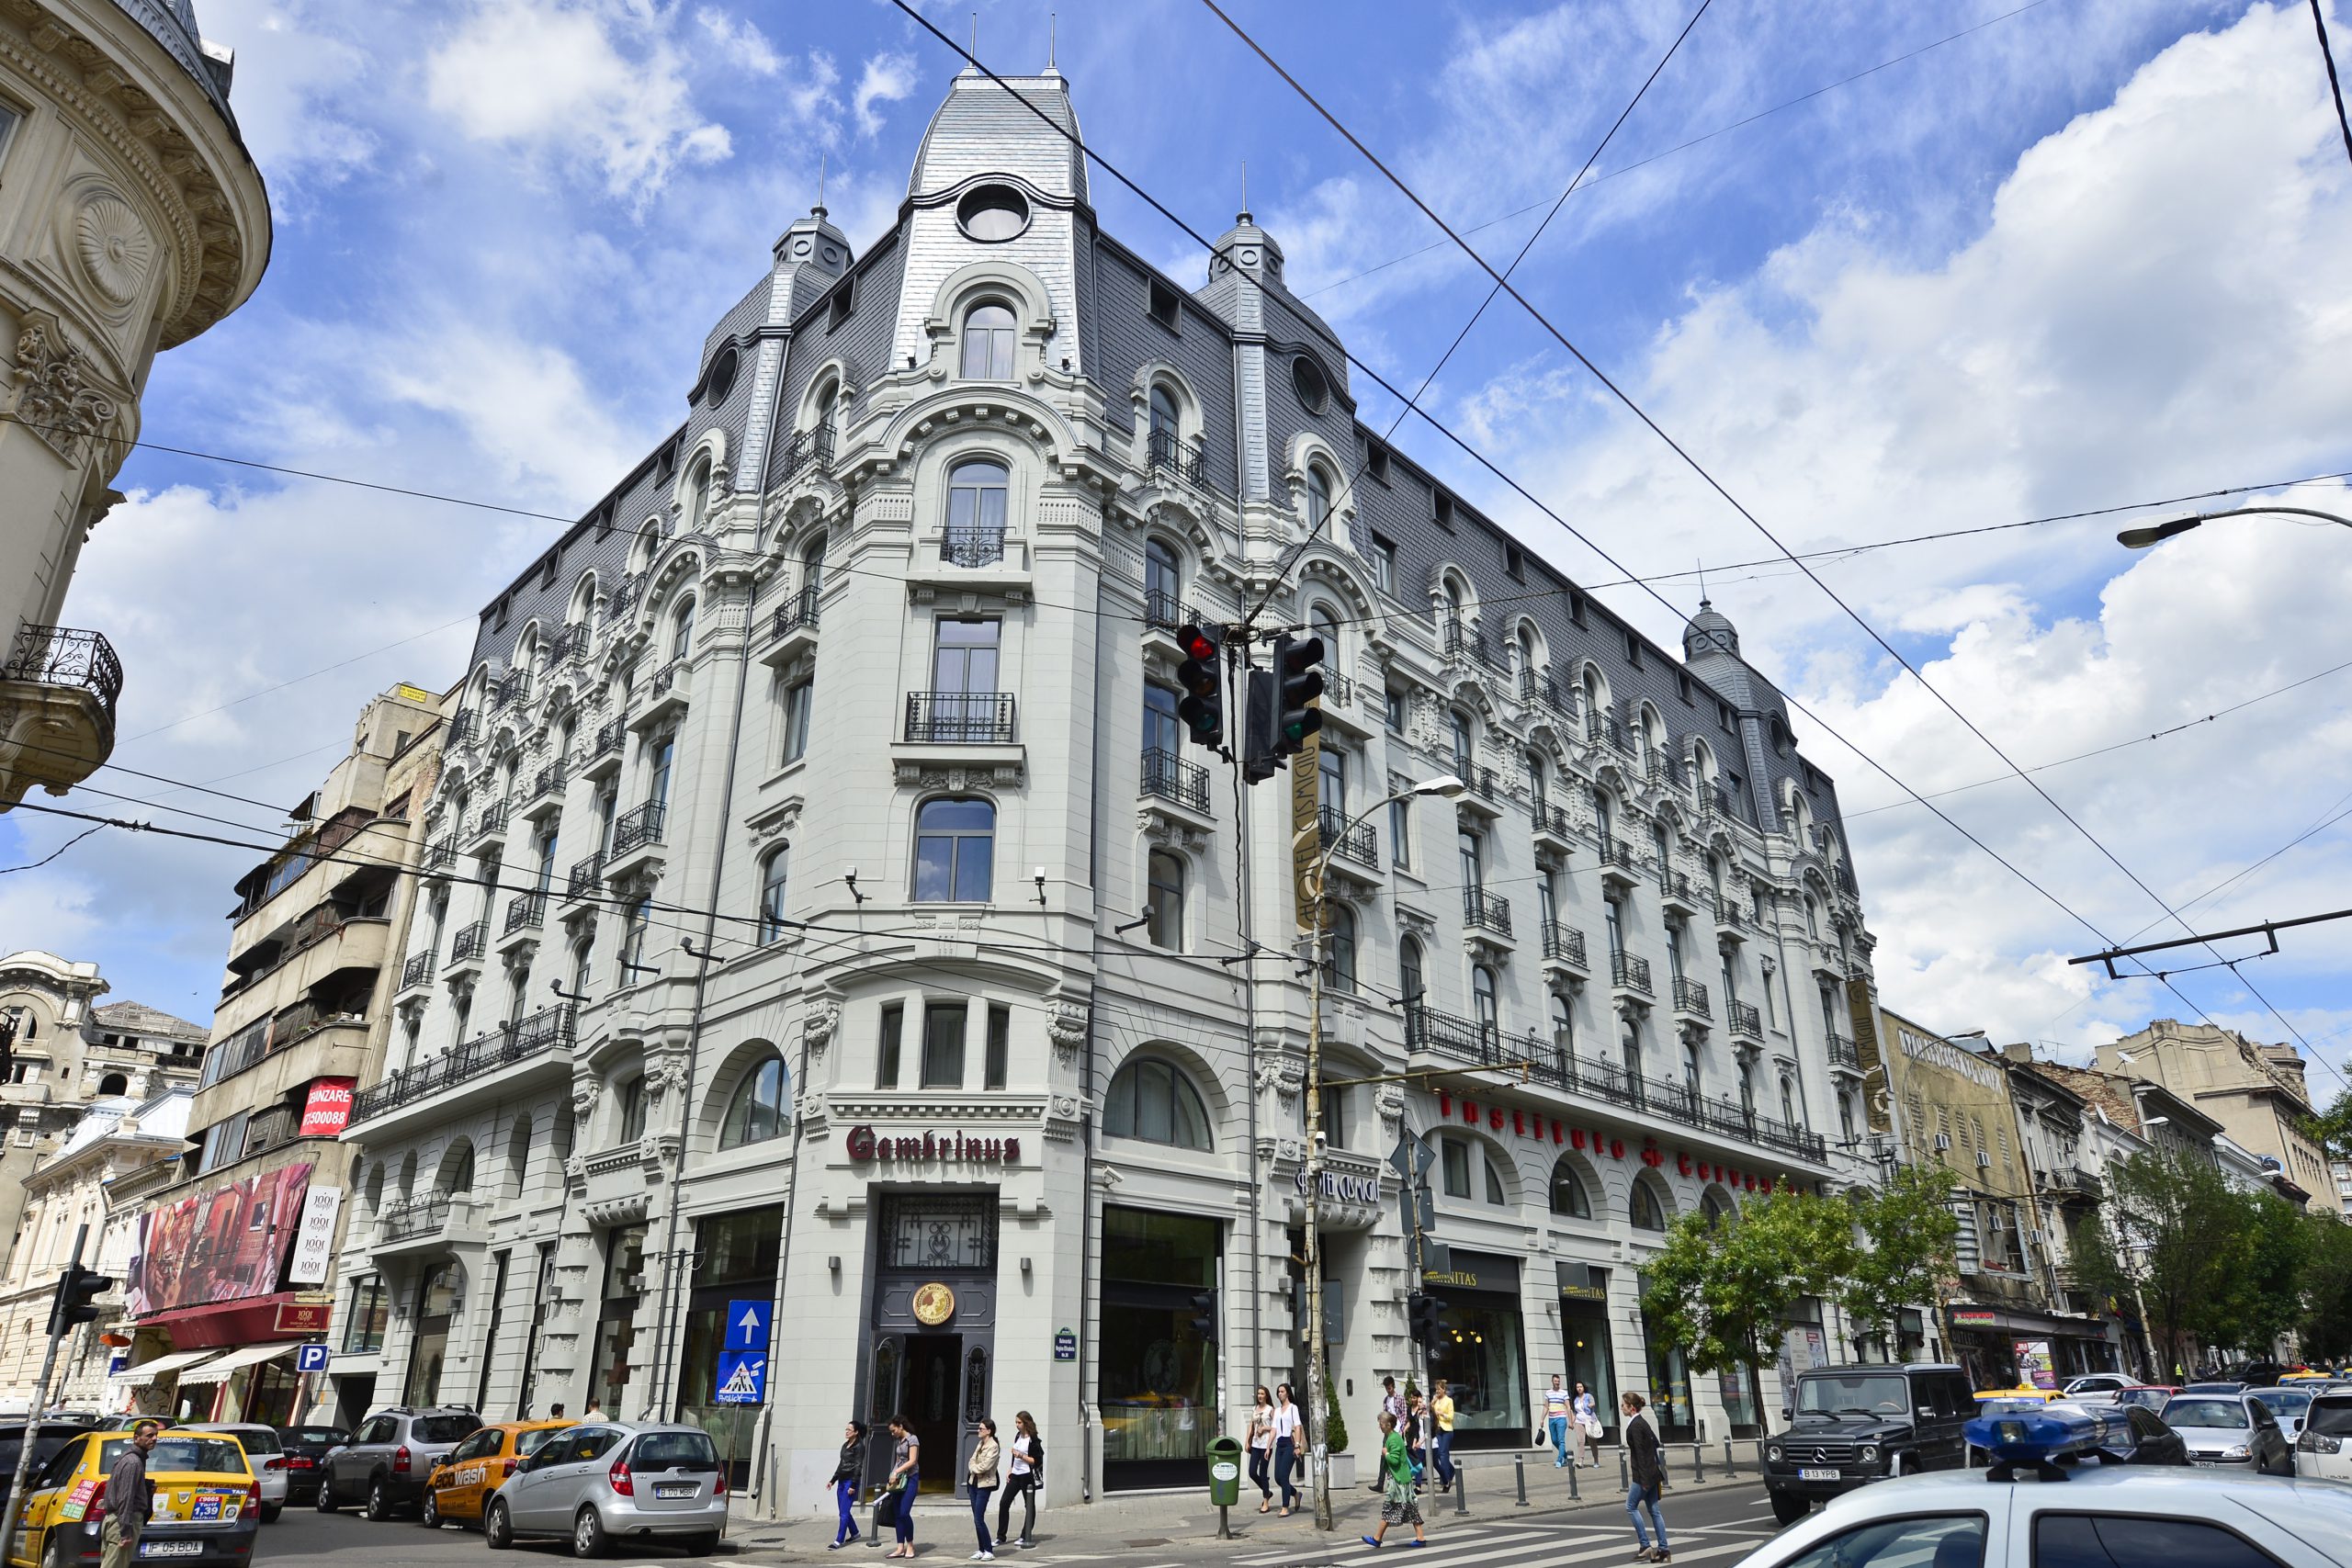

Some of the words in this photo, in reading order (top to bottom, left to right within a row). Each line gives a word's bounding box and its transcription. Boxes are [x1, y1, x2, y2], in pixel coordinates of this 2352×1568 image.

[1295, 747, 1317, 832] CISMIGIU
[1296, 841, 1320, 923] HOTEL
[1854, 1017, 1882, 1072] CISMIGIU
[1866, 1076, 1890, 1126] HOTEL
[846, 1123, 1020, 1160] Gambrinus
[1441, 1088, 1625, 1159] Instituto
[1678, 1150, 1795, 1198] Cervan
[304, 1348, 322, 1368] P
[194, 1506, 219, 1517] 1,39
[661, 1488, 666, 1496] B
[668, 1488, 678, 1496] 170
[148, 1542, 159, 1553] IF
[162, 1542, 175, 1553] 05
[177, 1541, 199, 1552] BDA
